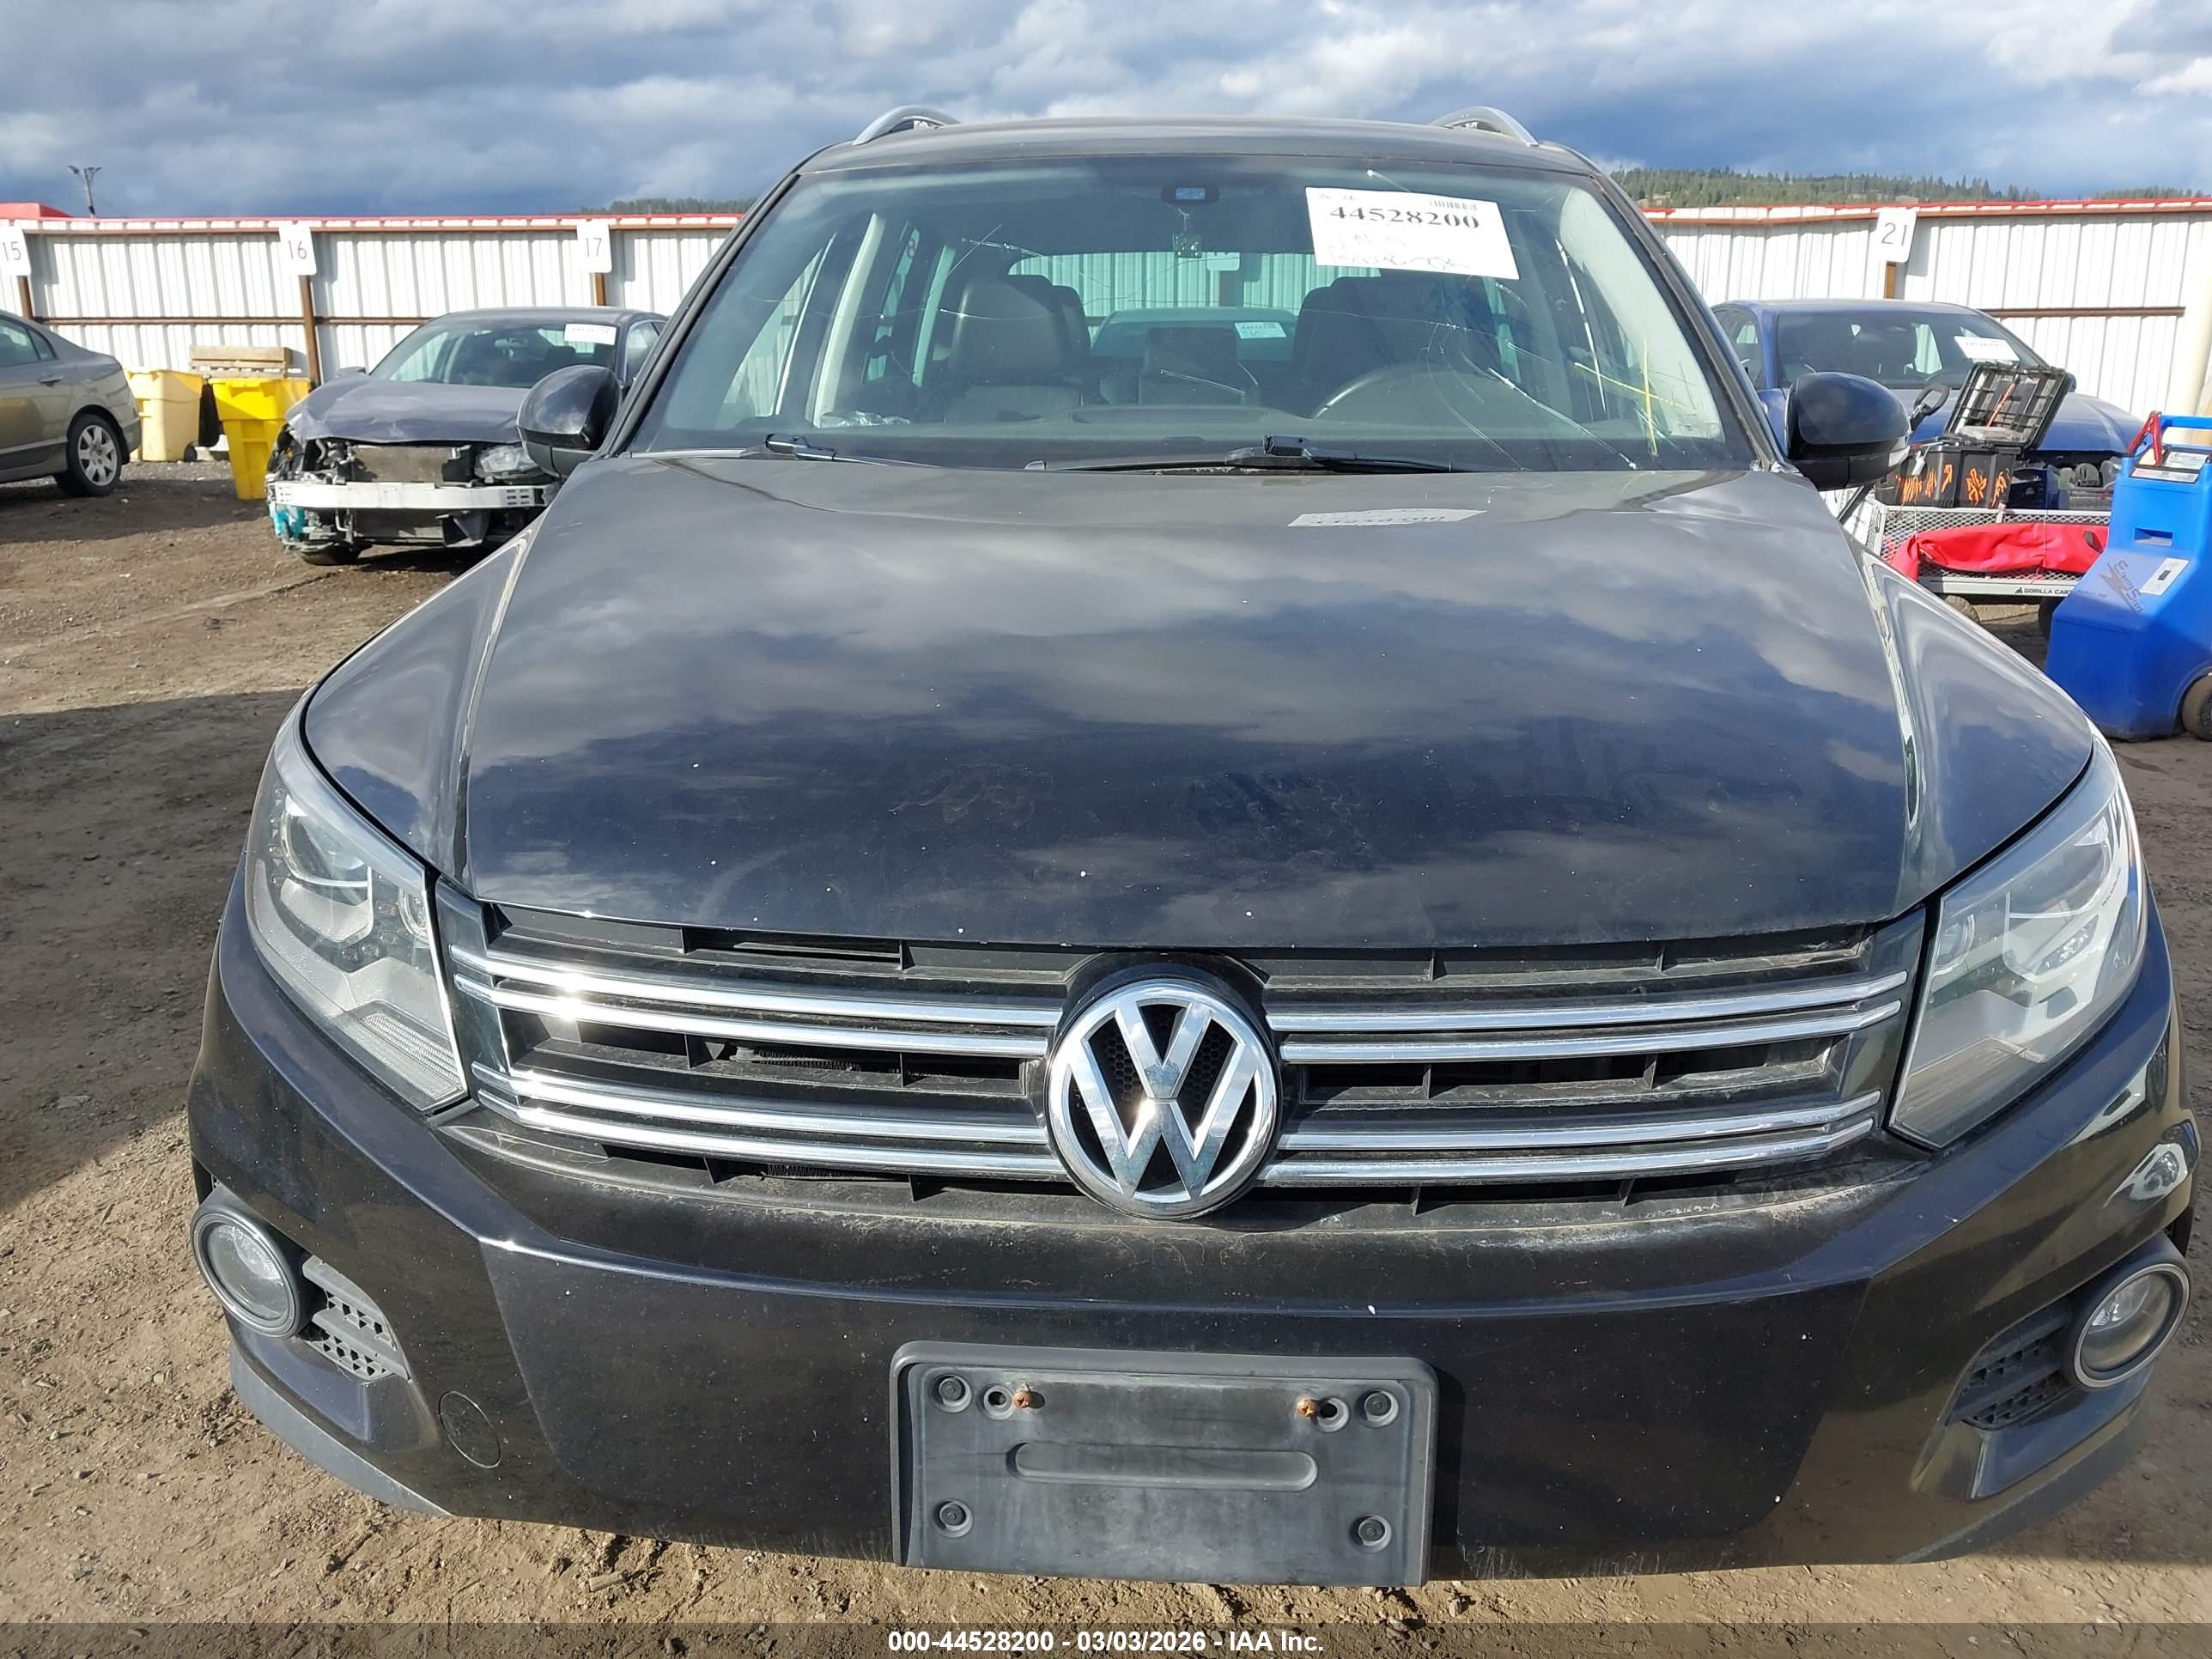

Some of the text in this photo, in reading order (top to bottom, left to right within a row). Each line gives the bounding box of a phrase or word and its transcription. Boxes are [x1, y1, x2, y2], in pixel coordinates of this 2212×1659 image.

[1329, 206, 1480, 228] 44528200
[1881, 222, 1907, 246] 21
[2, 240, 21, 262] 15
[288, 240, 307, 260] 16
[585, 237, 602, 258] 17
[1060, 992, 1264, 1204] VW
